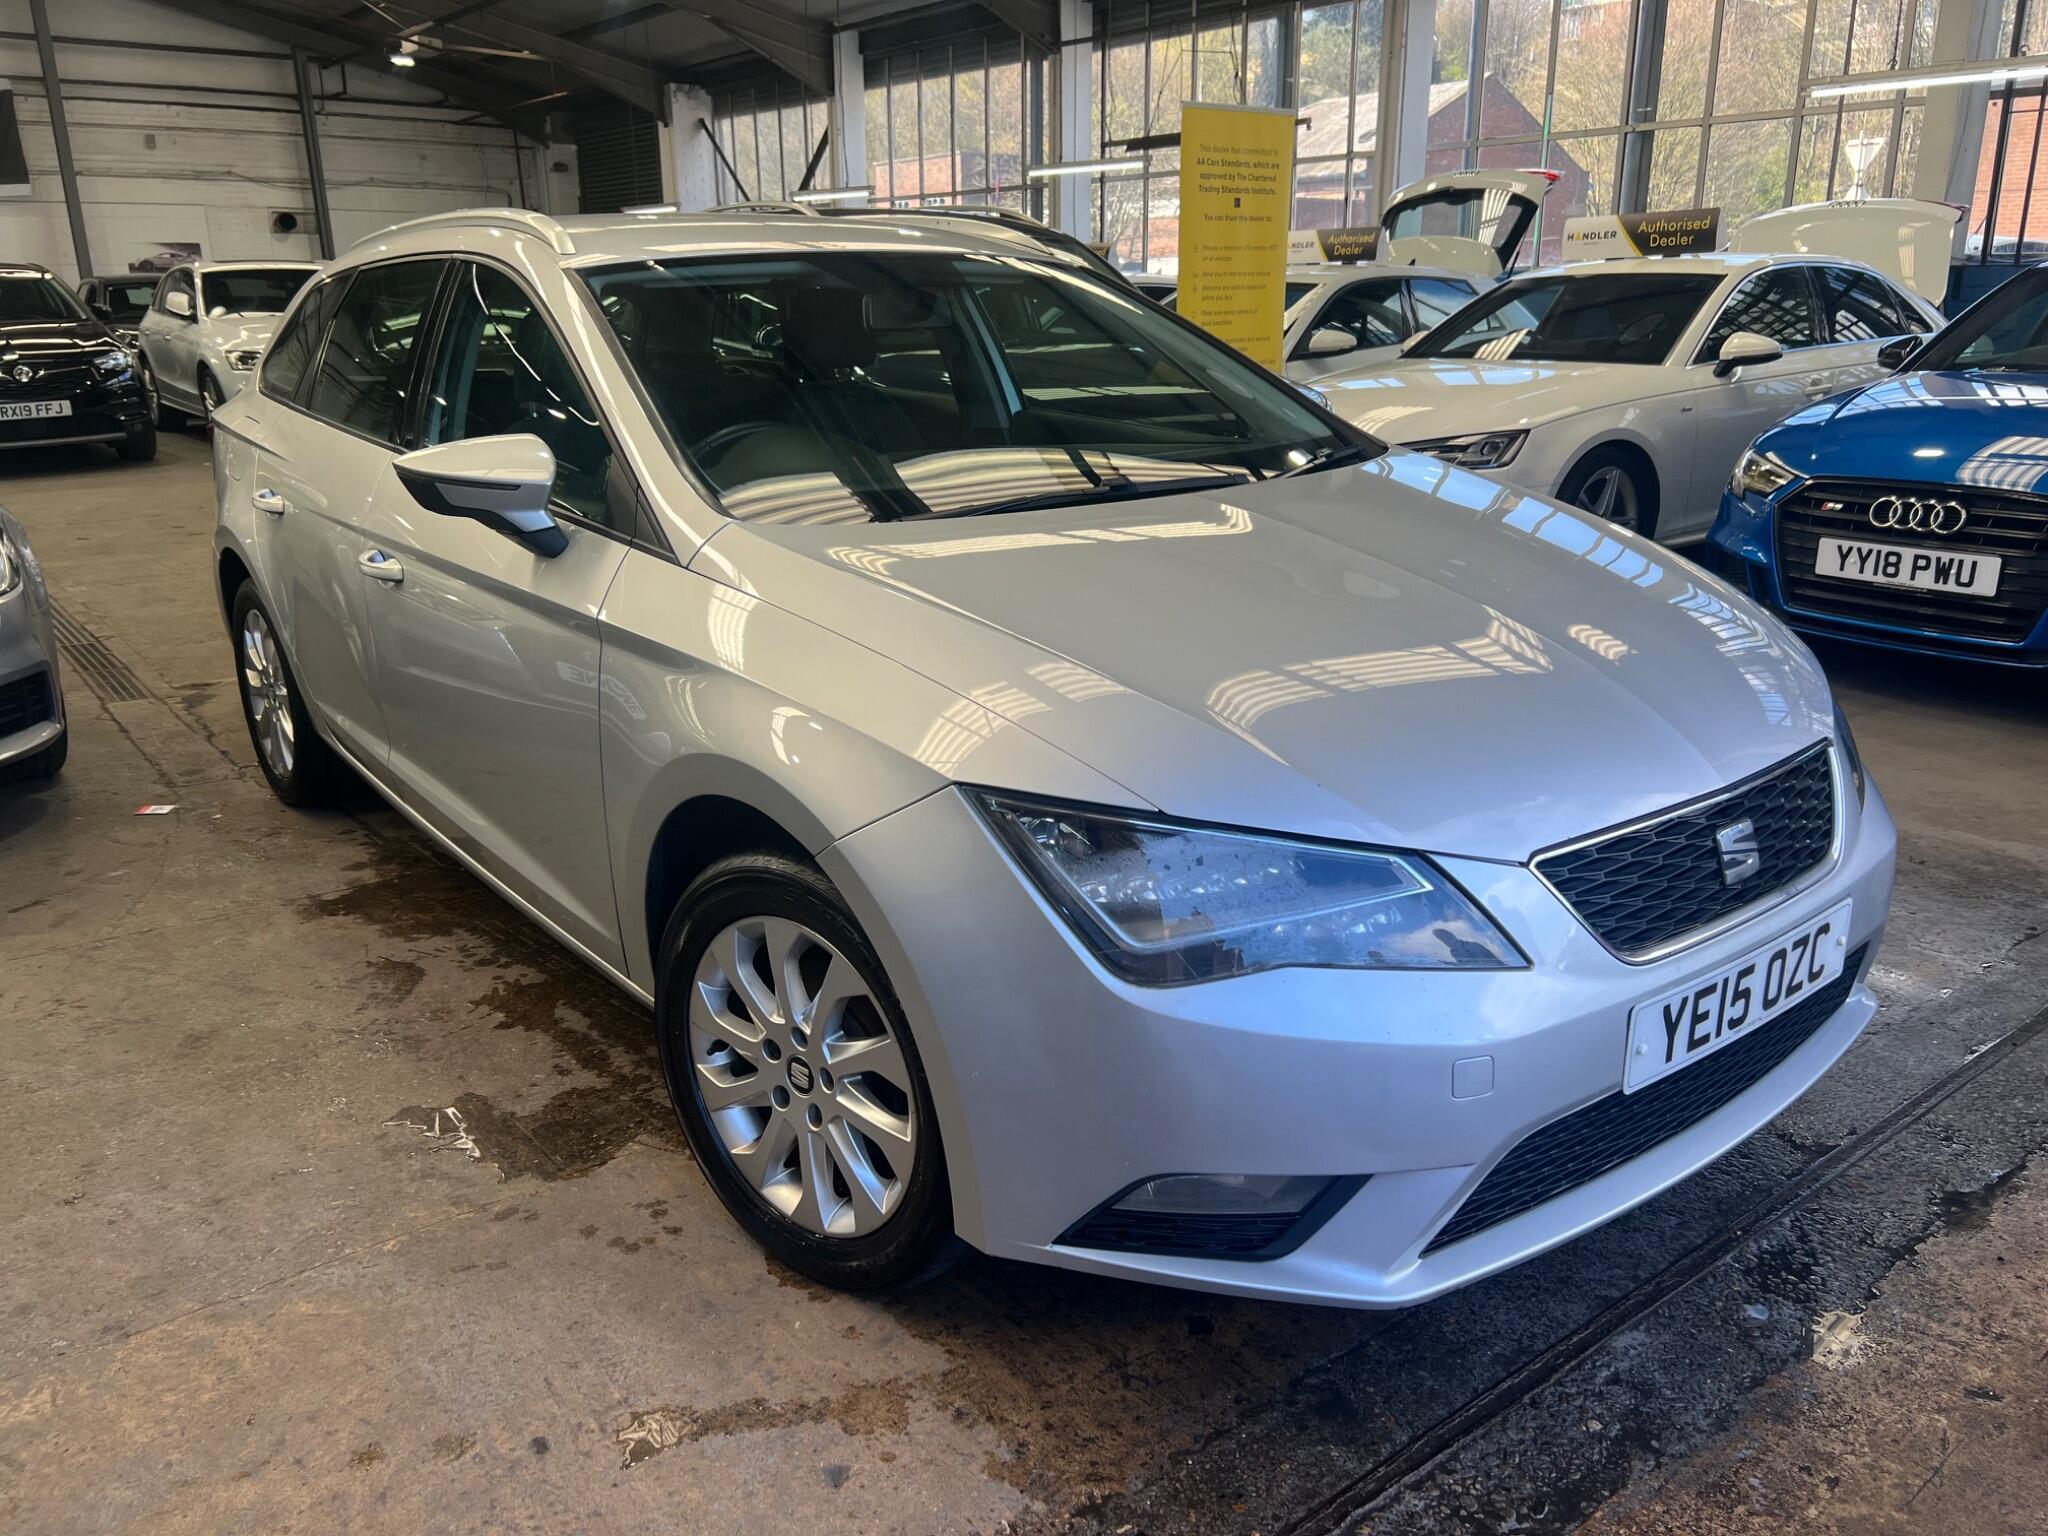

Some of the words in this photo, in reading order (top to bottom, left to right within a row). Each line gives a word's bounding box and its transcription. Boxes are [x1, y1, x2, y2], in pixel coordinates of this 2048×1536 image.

[1206, 158, 1220, 166] Cars
[1200, 173, 1227, 181] approved
[1228, 173, 1236, 181] by
[1198, 184, 1220, 194] Trading
[1637, 215, 1711, 234] Authorised
[1327, 232, 1376, 244] Authorised
[1650, 234, 1695, 248] Dealer
[1333, 245, 1364, 255] Dealer
[0, 404, 32, 419] RX19
[36, 402, 63, 416] FFJ
[1837, 544, 1902, 579] YY18
[1909, 553, 1978, 588] PWU
[1662, 962, 1756, 1064] YE15
[1762, 922, 1831, 1012] OZC
